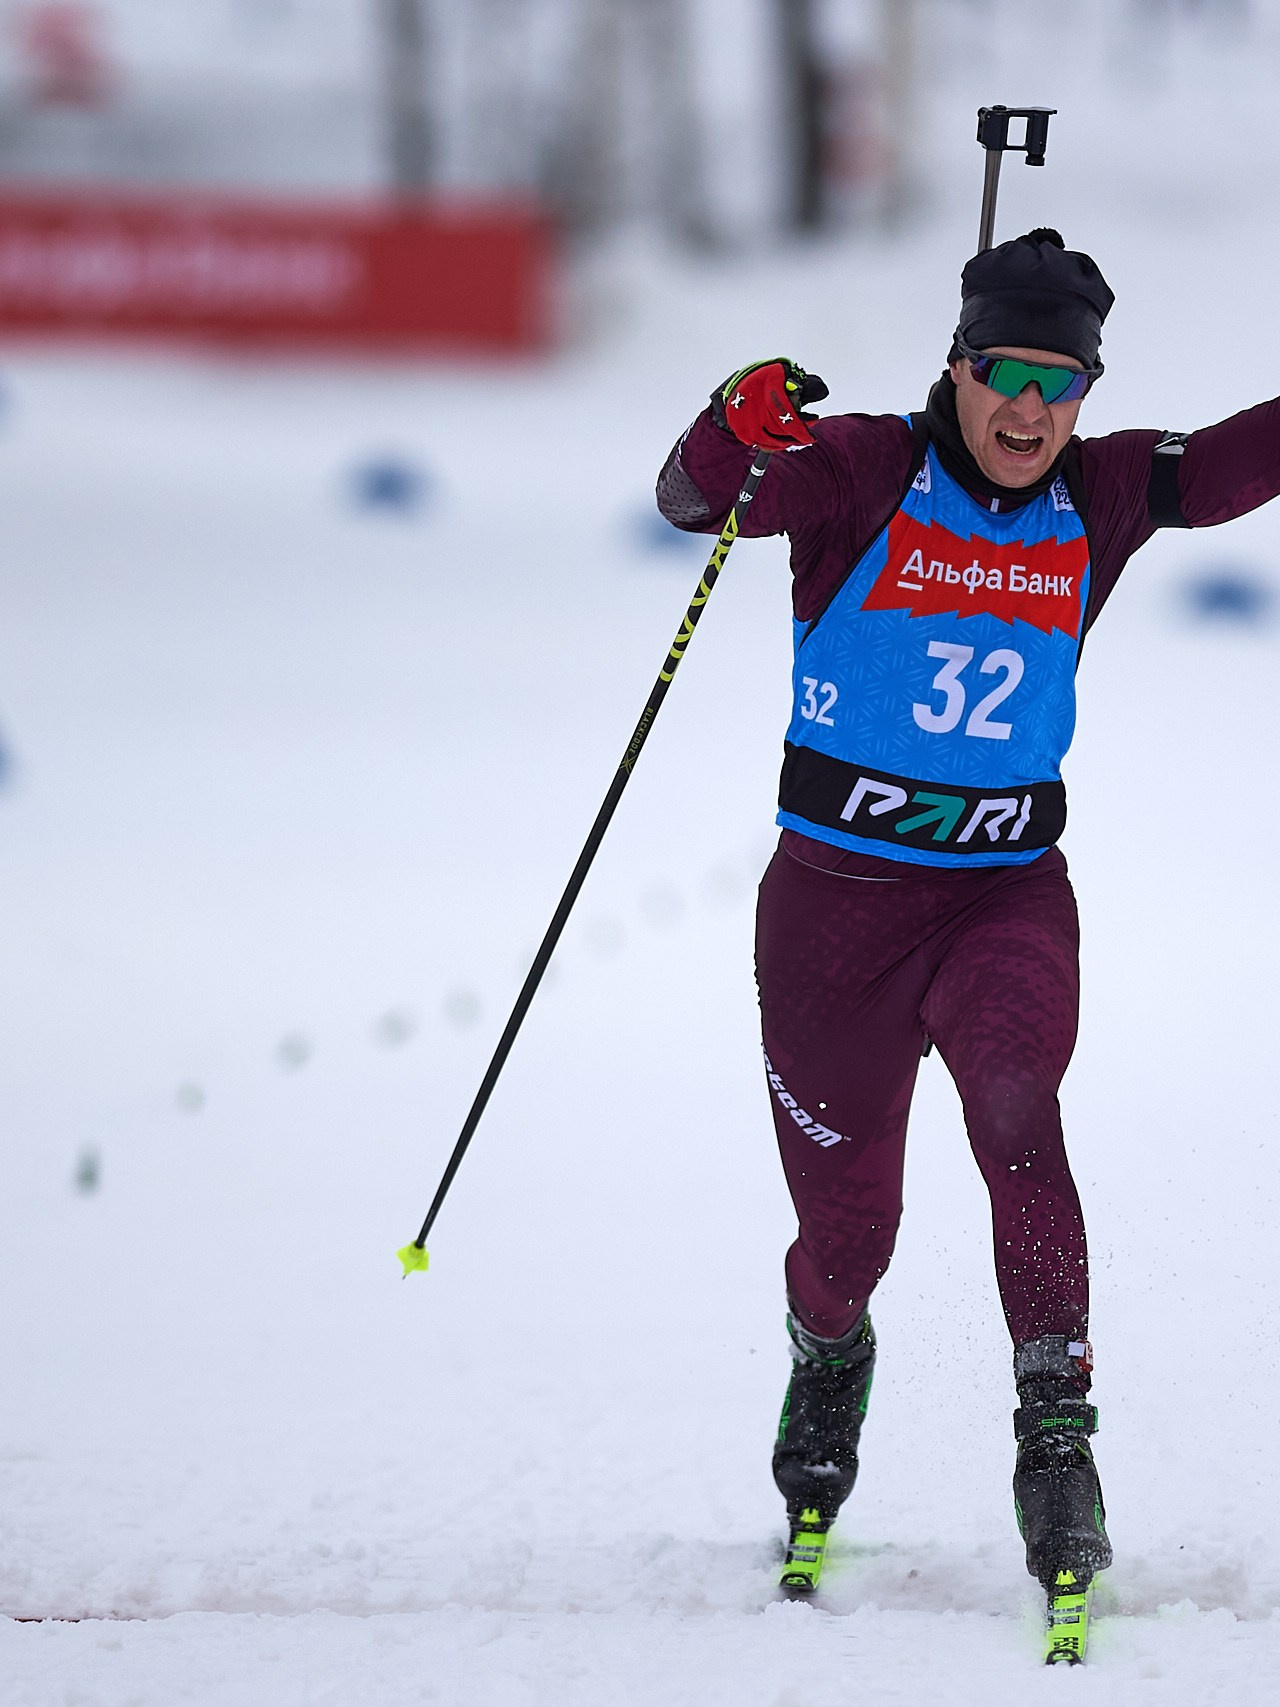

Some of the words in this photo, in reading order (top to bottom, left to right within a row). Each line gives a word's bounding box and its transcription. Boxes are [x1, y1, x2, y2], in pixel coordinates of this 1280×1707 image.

[898, 549, 1002, 596] Альфа
[1009, 565, 1075, 597] Банк
[801, 676, 839, 727] 32
[912, 640, 1025, 740] 32
[630, 707, 654, 753] BLACKCODE
[840, 776, 1034, 842] PARI
[1041, 1416, 1085, 1427] SPINE
